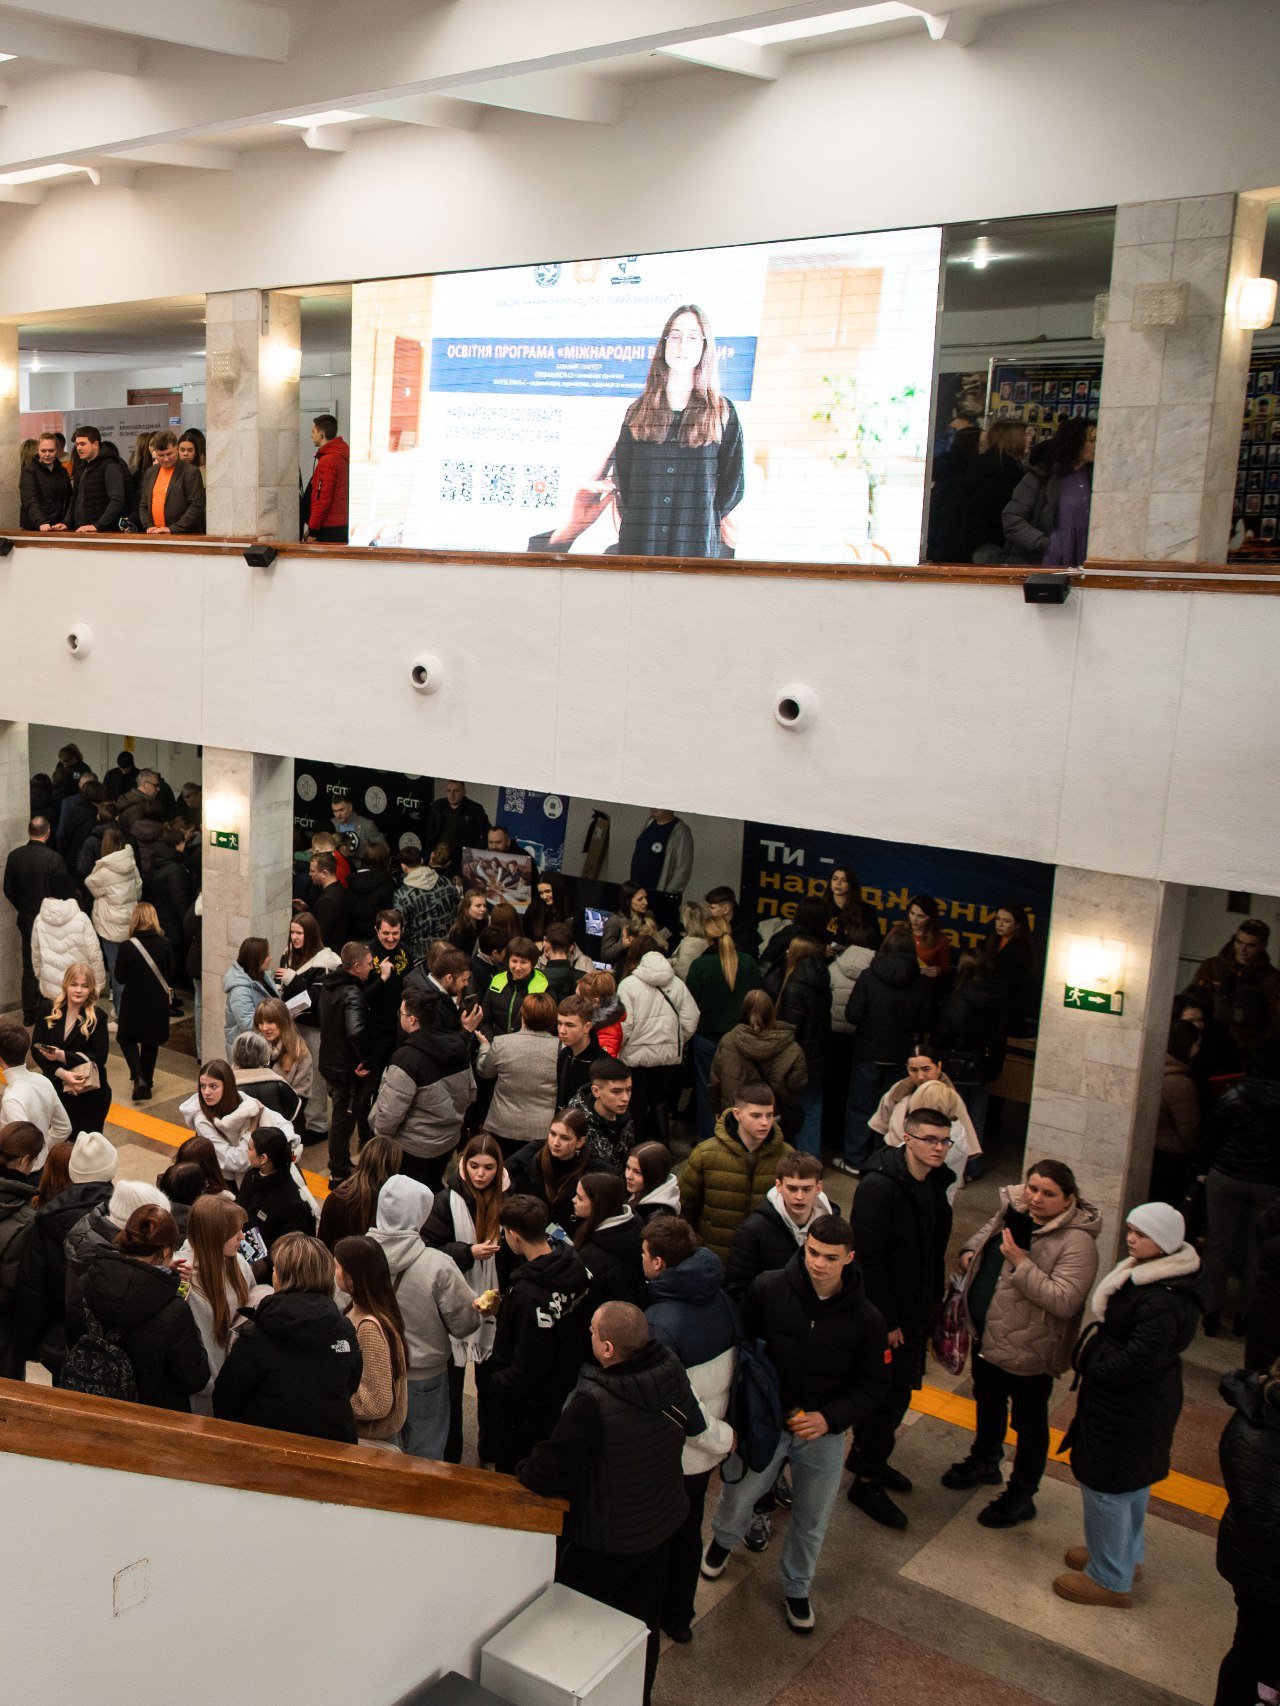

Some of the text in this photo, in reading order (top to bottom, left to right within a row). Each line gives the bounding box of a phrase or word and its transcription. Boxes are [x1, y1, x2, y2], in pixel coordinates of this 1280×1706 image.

[447, 344, 493, 359] ОСВІТНЯ
[495, 344, 555, 360] ПРОГРАМА
[558, 345, 645, 362] «МІЖНАРОДНІ
[326, 783, 349, 796] FCIT
[396, 796, 420, 809] FCIT
[759, 839, 806, 867] Ти
